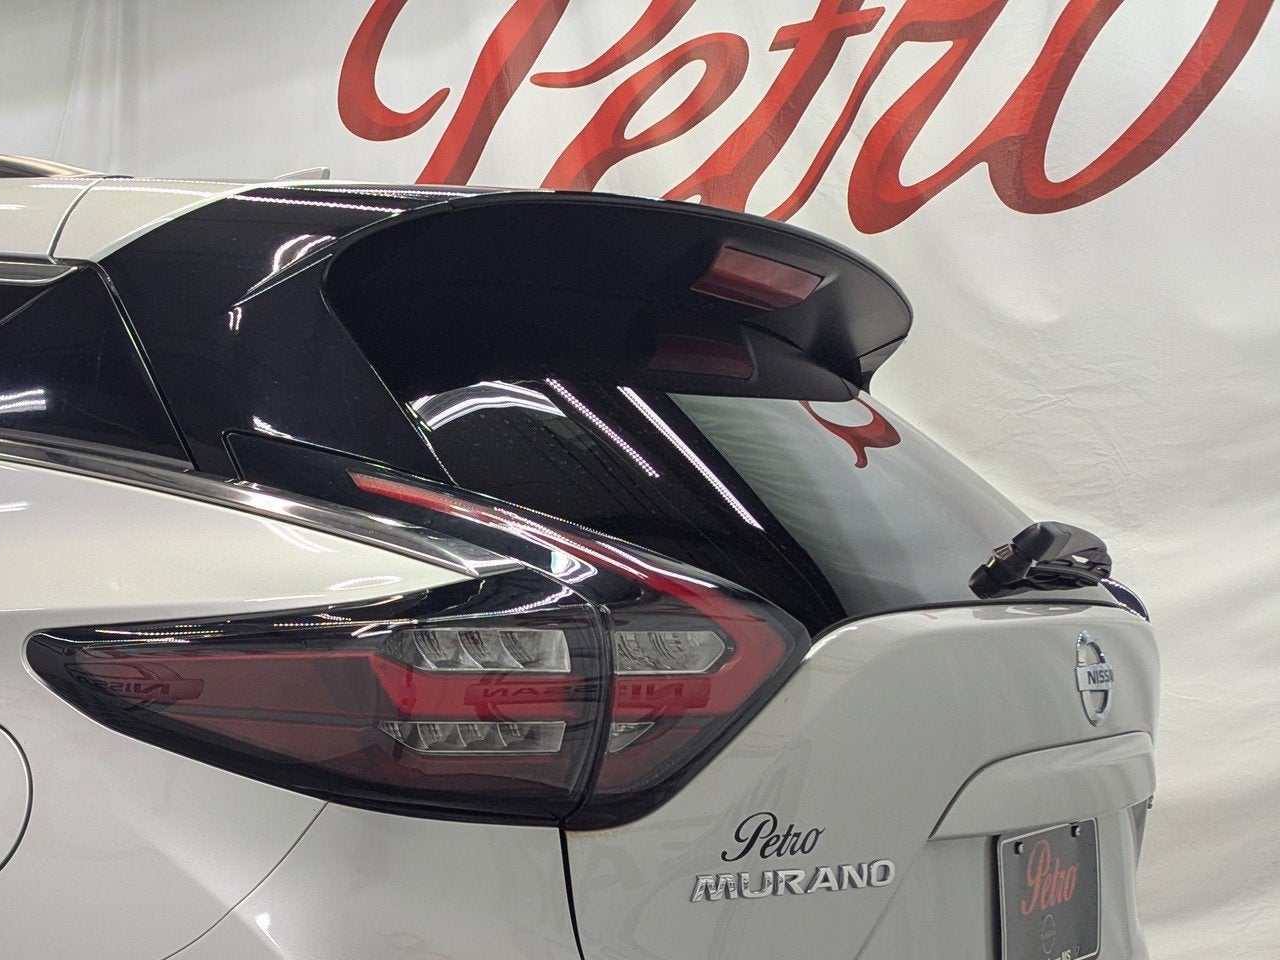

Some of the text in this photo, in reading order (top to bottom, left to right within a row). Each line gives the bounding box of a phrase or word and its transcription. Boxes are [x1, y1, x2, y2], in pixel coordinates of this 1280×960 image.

[721, 812, 825, 862] Petro
[690, 859, 896, 903] MURANO
[1021, 839, 1078, 915] Petro
